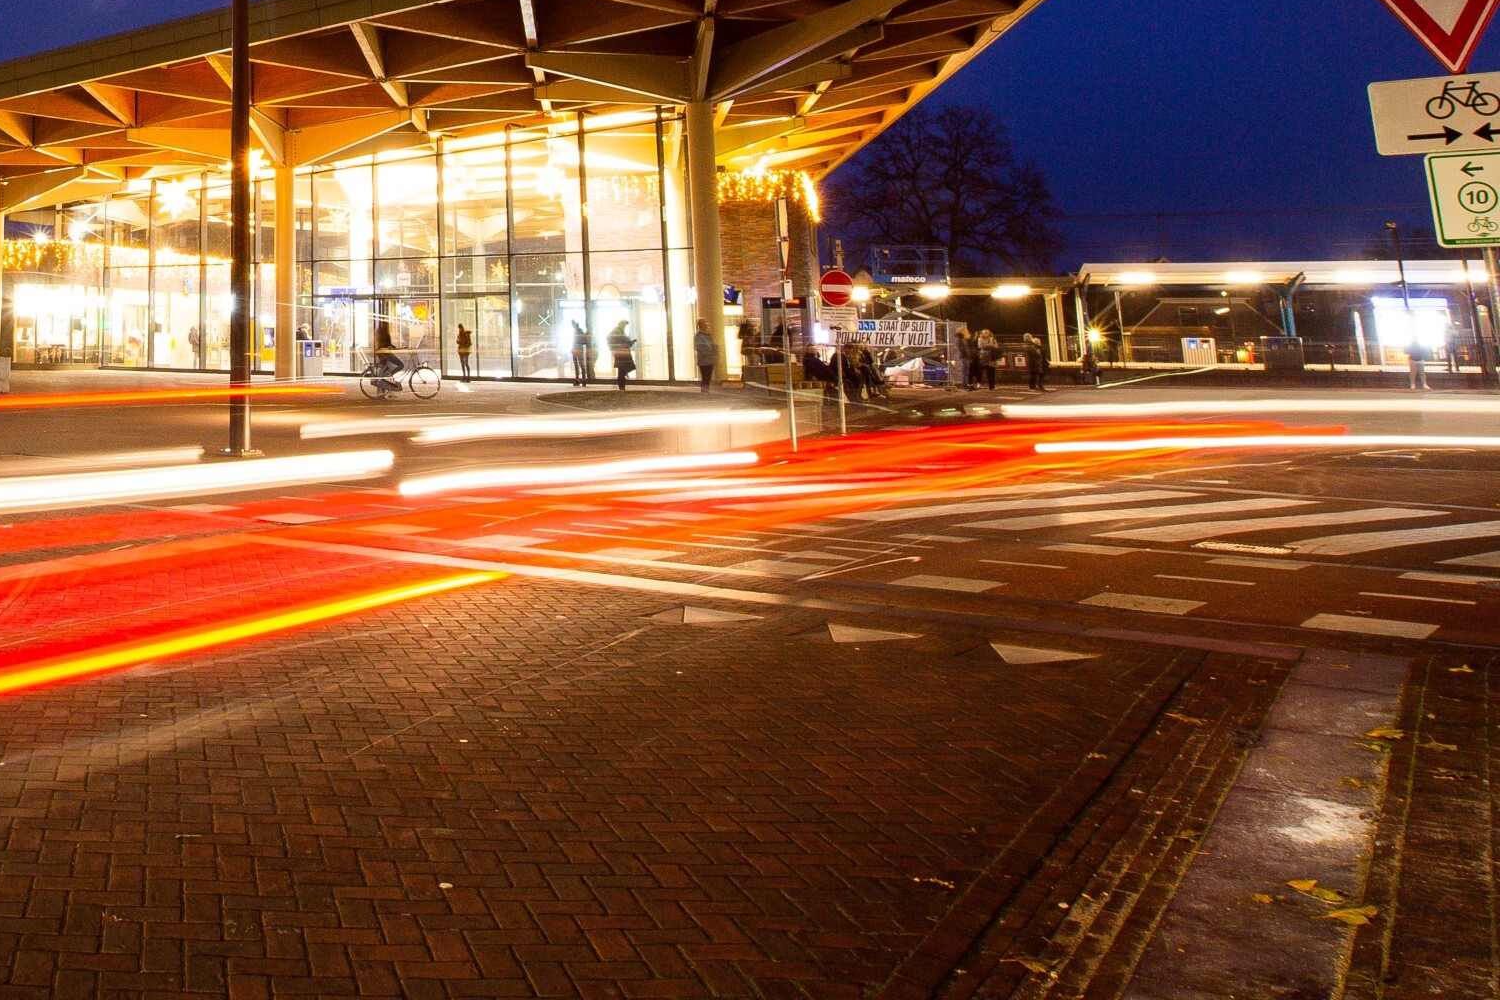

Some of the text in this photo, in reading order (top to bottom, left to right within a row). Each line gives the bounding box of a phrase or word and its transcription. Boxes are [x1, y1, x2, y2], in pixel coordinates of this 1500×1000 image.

[1466, 190, 1488, 204] 10
[879, 321, 898, 331] STAAT
[900, 321, 909, 331] OP
[911, 321, 929, 331] SLOT
[875, 333, 896, 345] TREK
